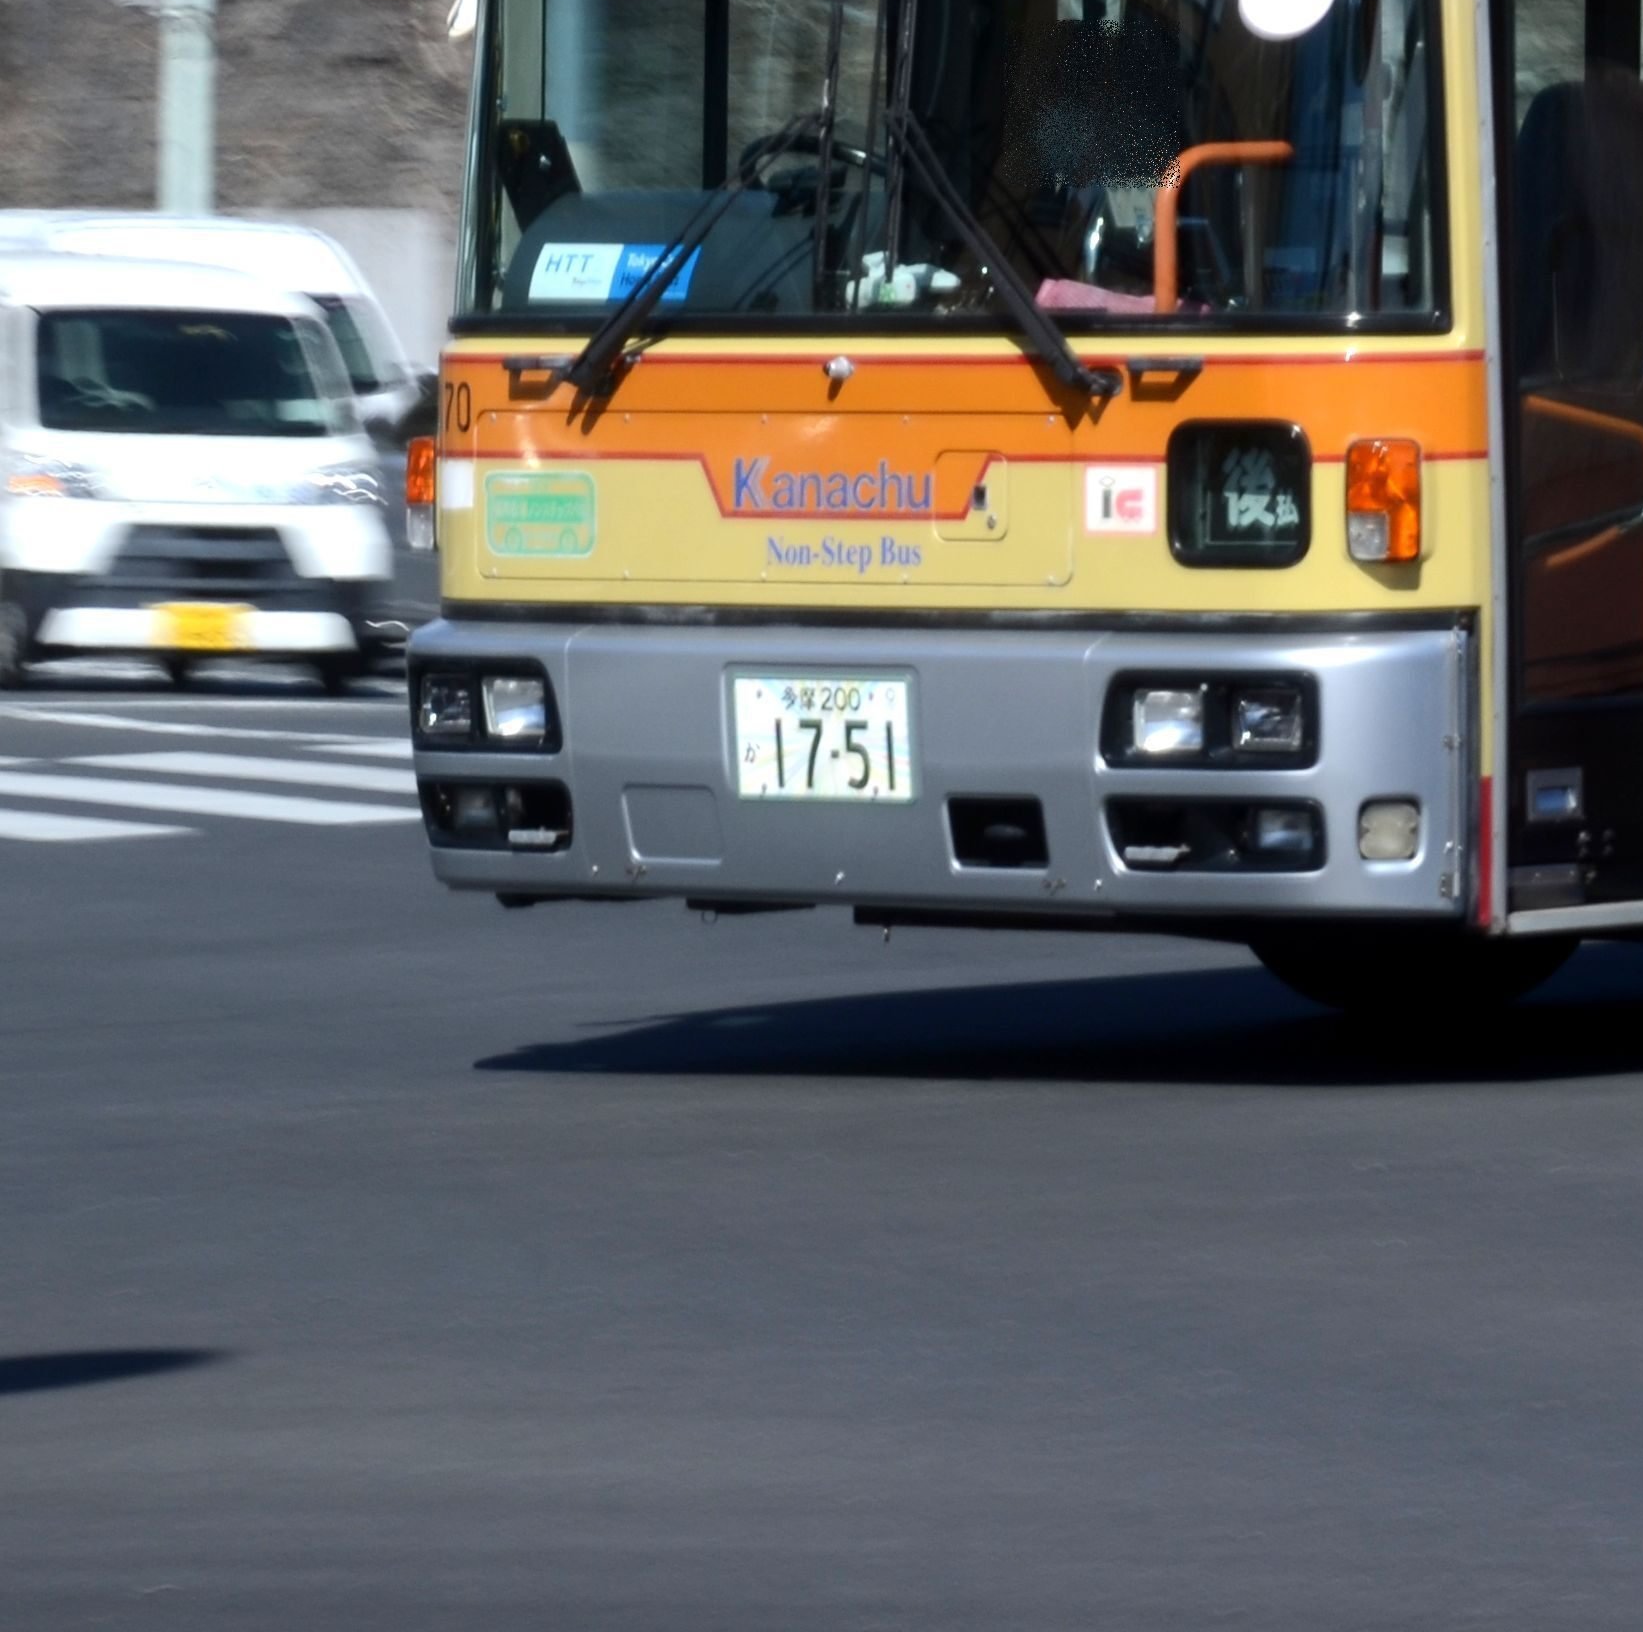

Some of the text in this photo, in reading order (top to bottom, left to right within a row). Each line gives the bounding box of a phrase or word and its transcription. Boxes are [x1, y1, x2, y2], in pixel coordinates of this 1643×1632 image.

[545, 254, 593, 273] HTT
[445, 382, 471, 433] 70
[733, 457, 932, 510] Kanachu
[766, 534, 923, 574] Non-Step Bus
